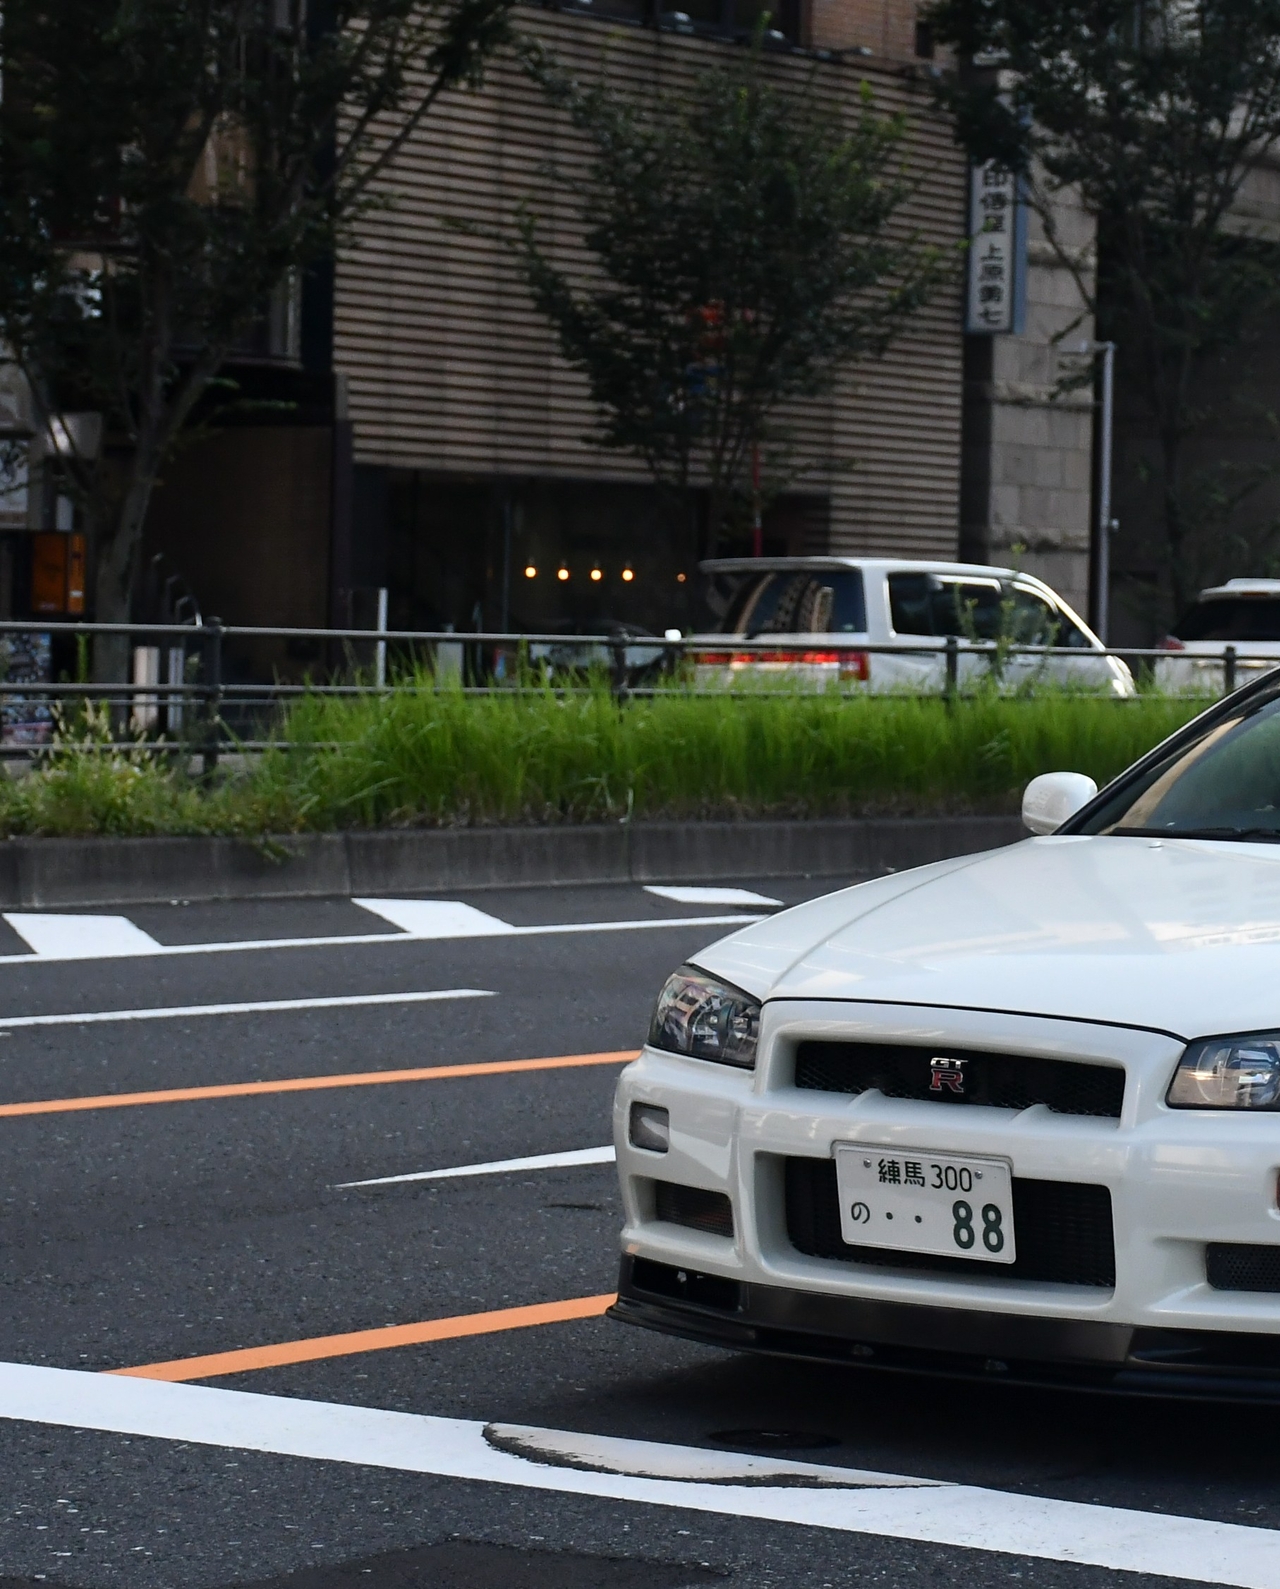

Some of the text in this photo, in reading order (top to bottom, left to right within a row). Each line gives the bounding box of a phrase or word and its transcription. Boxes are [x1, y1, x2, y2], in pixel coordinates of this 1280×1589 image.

[930, 1057, 968, 1069] GT
[929, 1068, 964, 1092] R
[878, 1158, 972, 1192] 練馬 300
[952, 1200, 1004, 1253] 88
